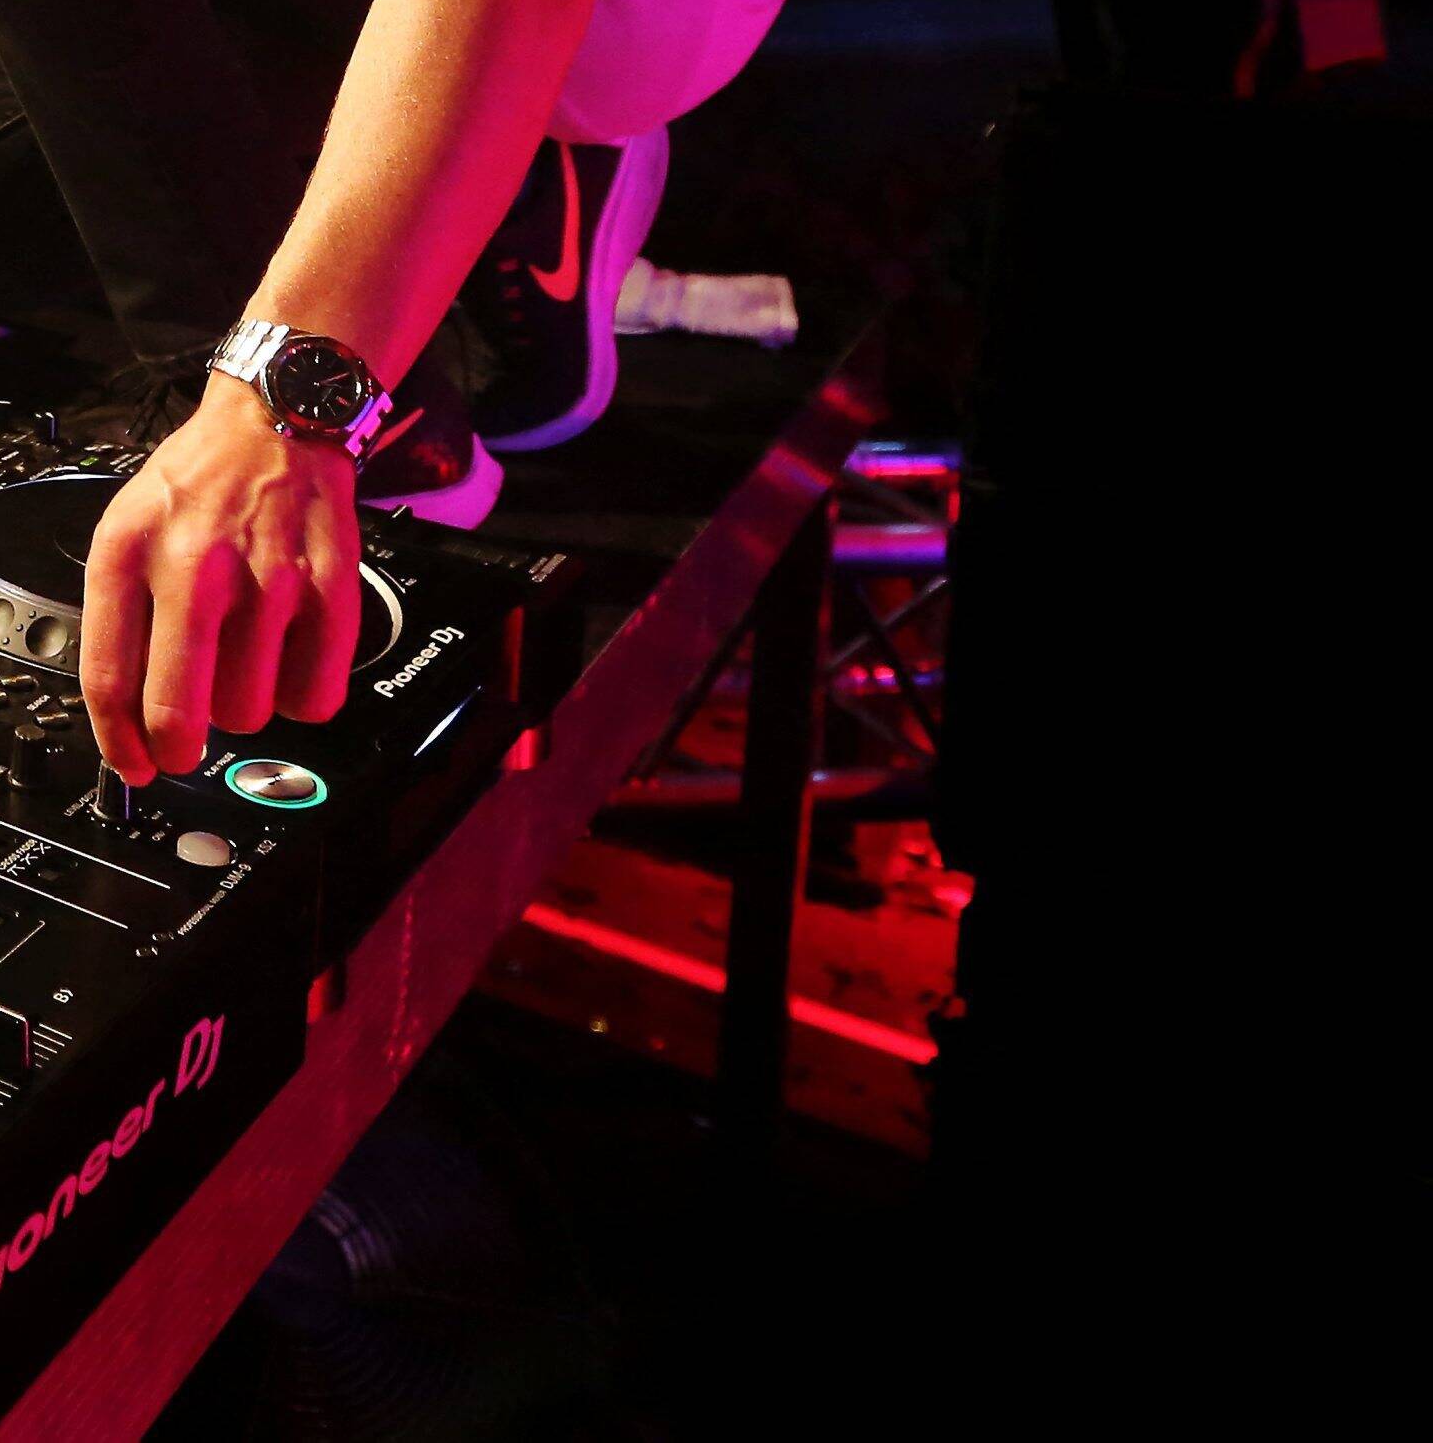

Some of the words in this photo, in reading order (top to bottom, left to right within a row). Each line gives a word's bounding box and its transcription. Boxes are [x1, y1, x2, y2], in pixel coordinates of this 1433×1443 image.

[373, 640, 442, 698] Pioneer
[430, 626, 465, 645] DJ
[173, 1013, 226, 1098] DJ
